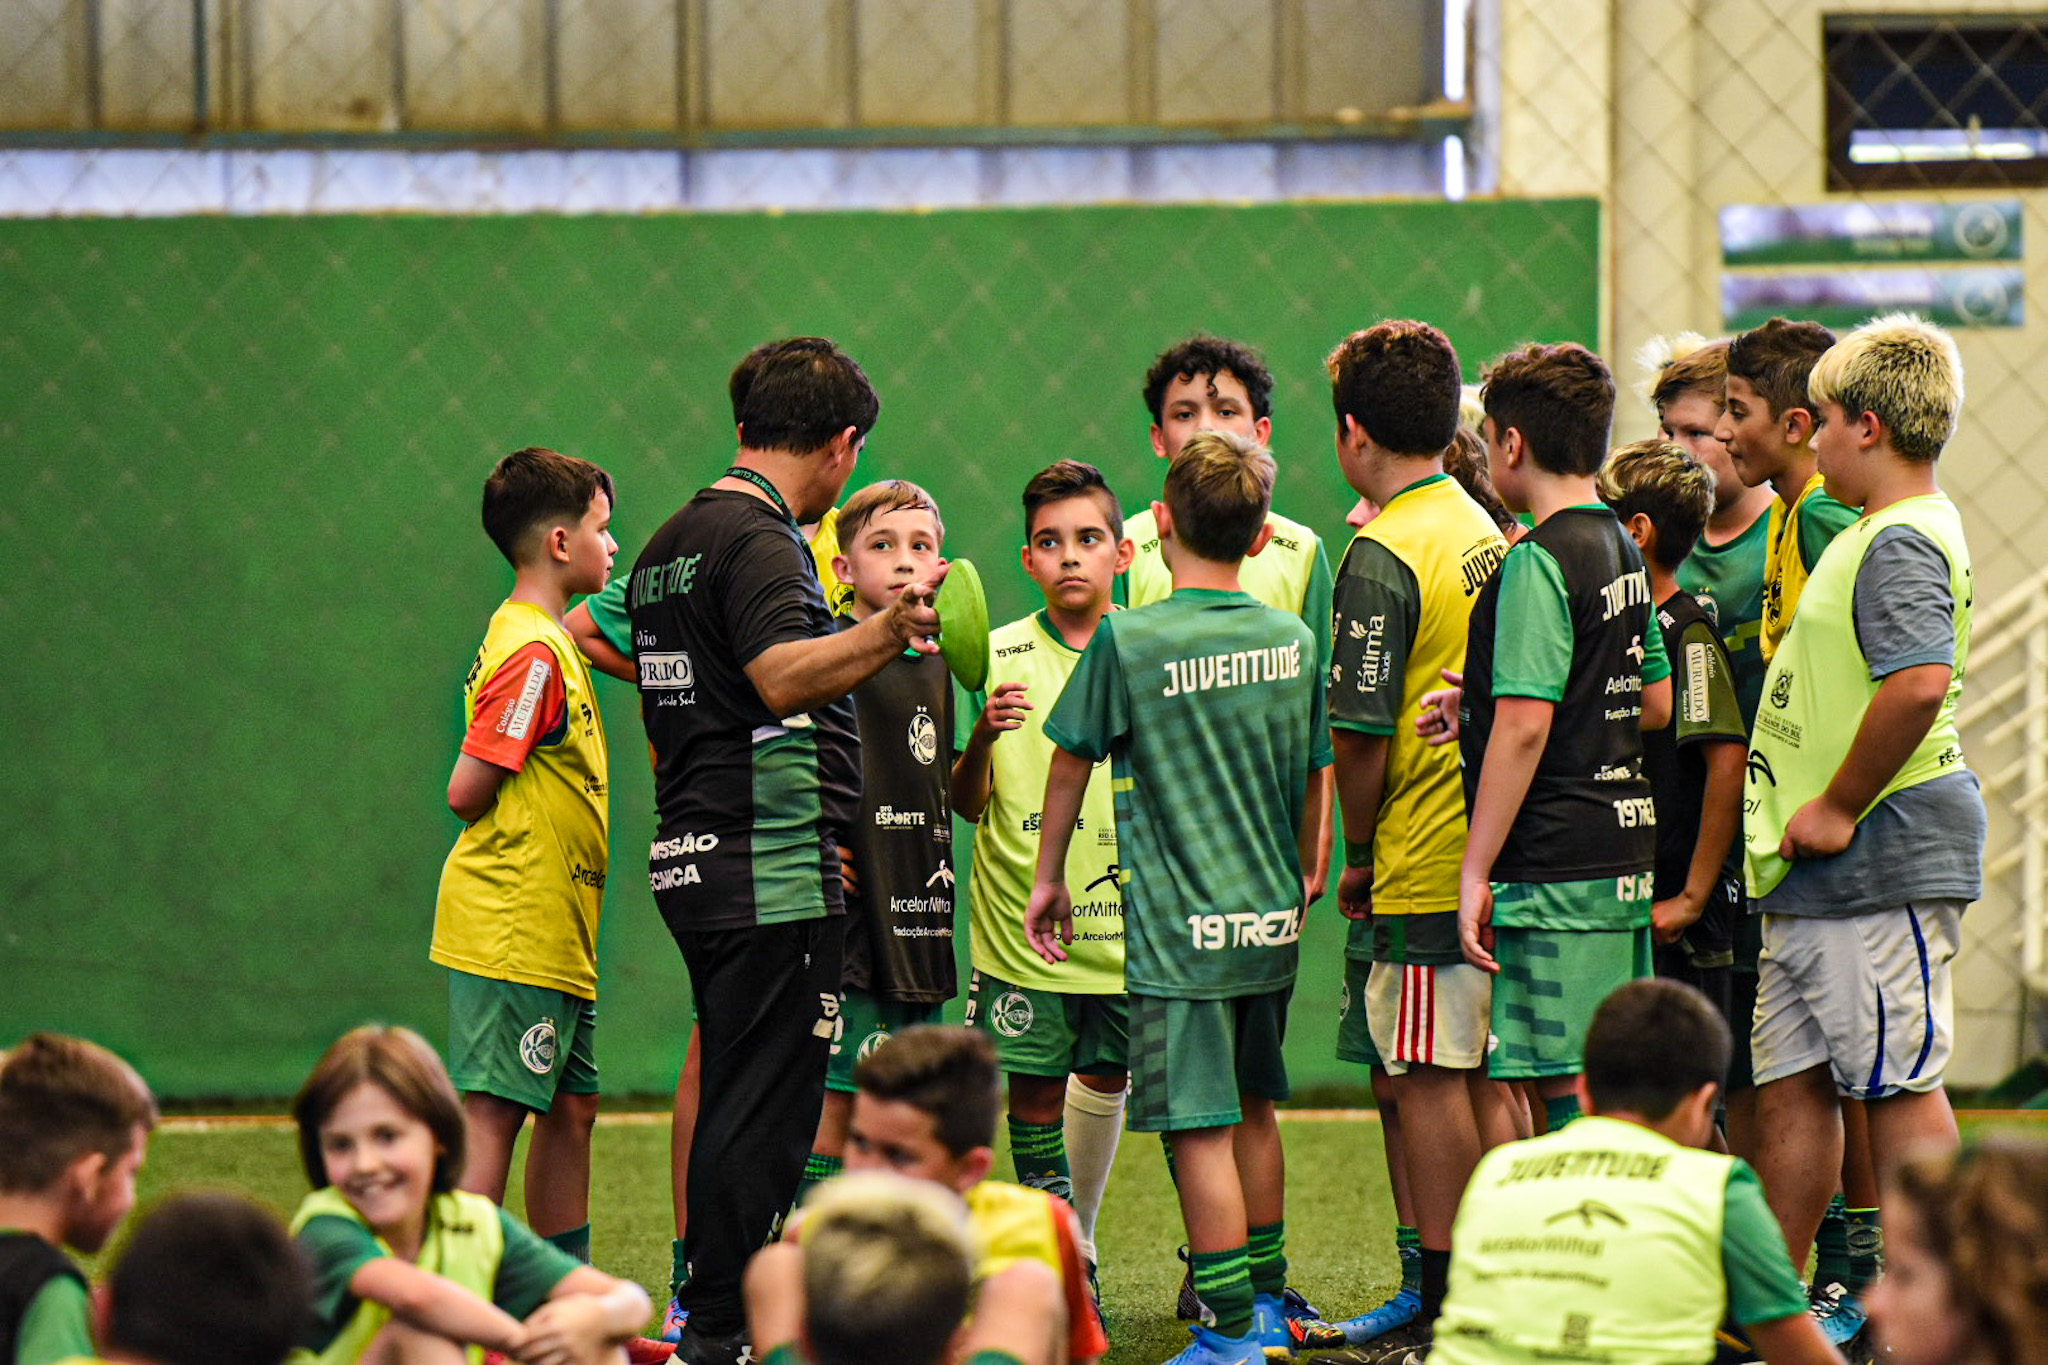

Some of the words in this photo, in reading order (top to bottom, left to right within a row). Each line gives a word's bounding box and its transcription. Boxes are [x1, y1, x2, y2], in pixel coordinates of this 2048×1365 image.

[1357, 614, 1386, 693] fátima
[511, 663, 545, 732] MURIALDO
[1691, 649, 1705, 718] MURIALDO
[875, 811, 926, 826] ESPORTE
[571, 862, 606, 889] Arcelo
[1187, 906, 1300, 951] 19TREZE
